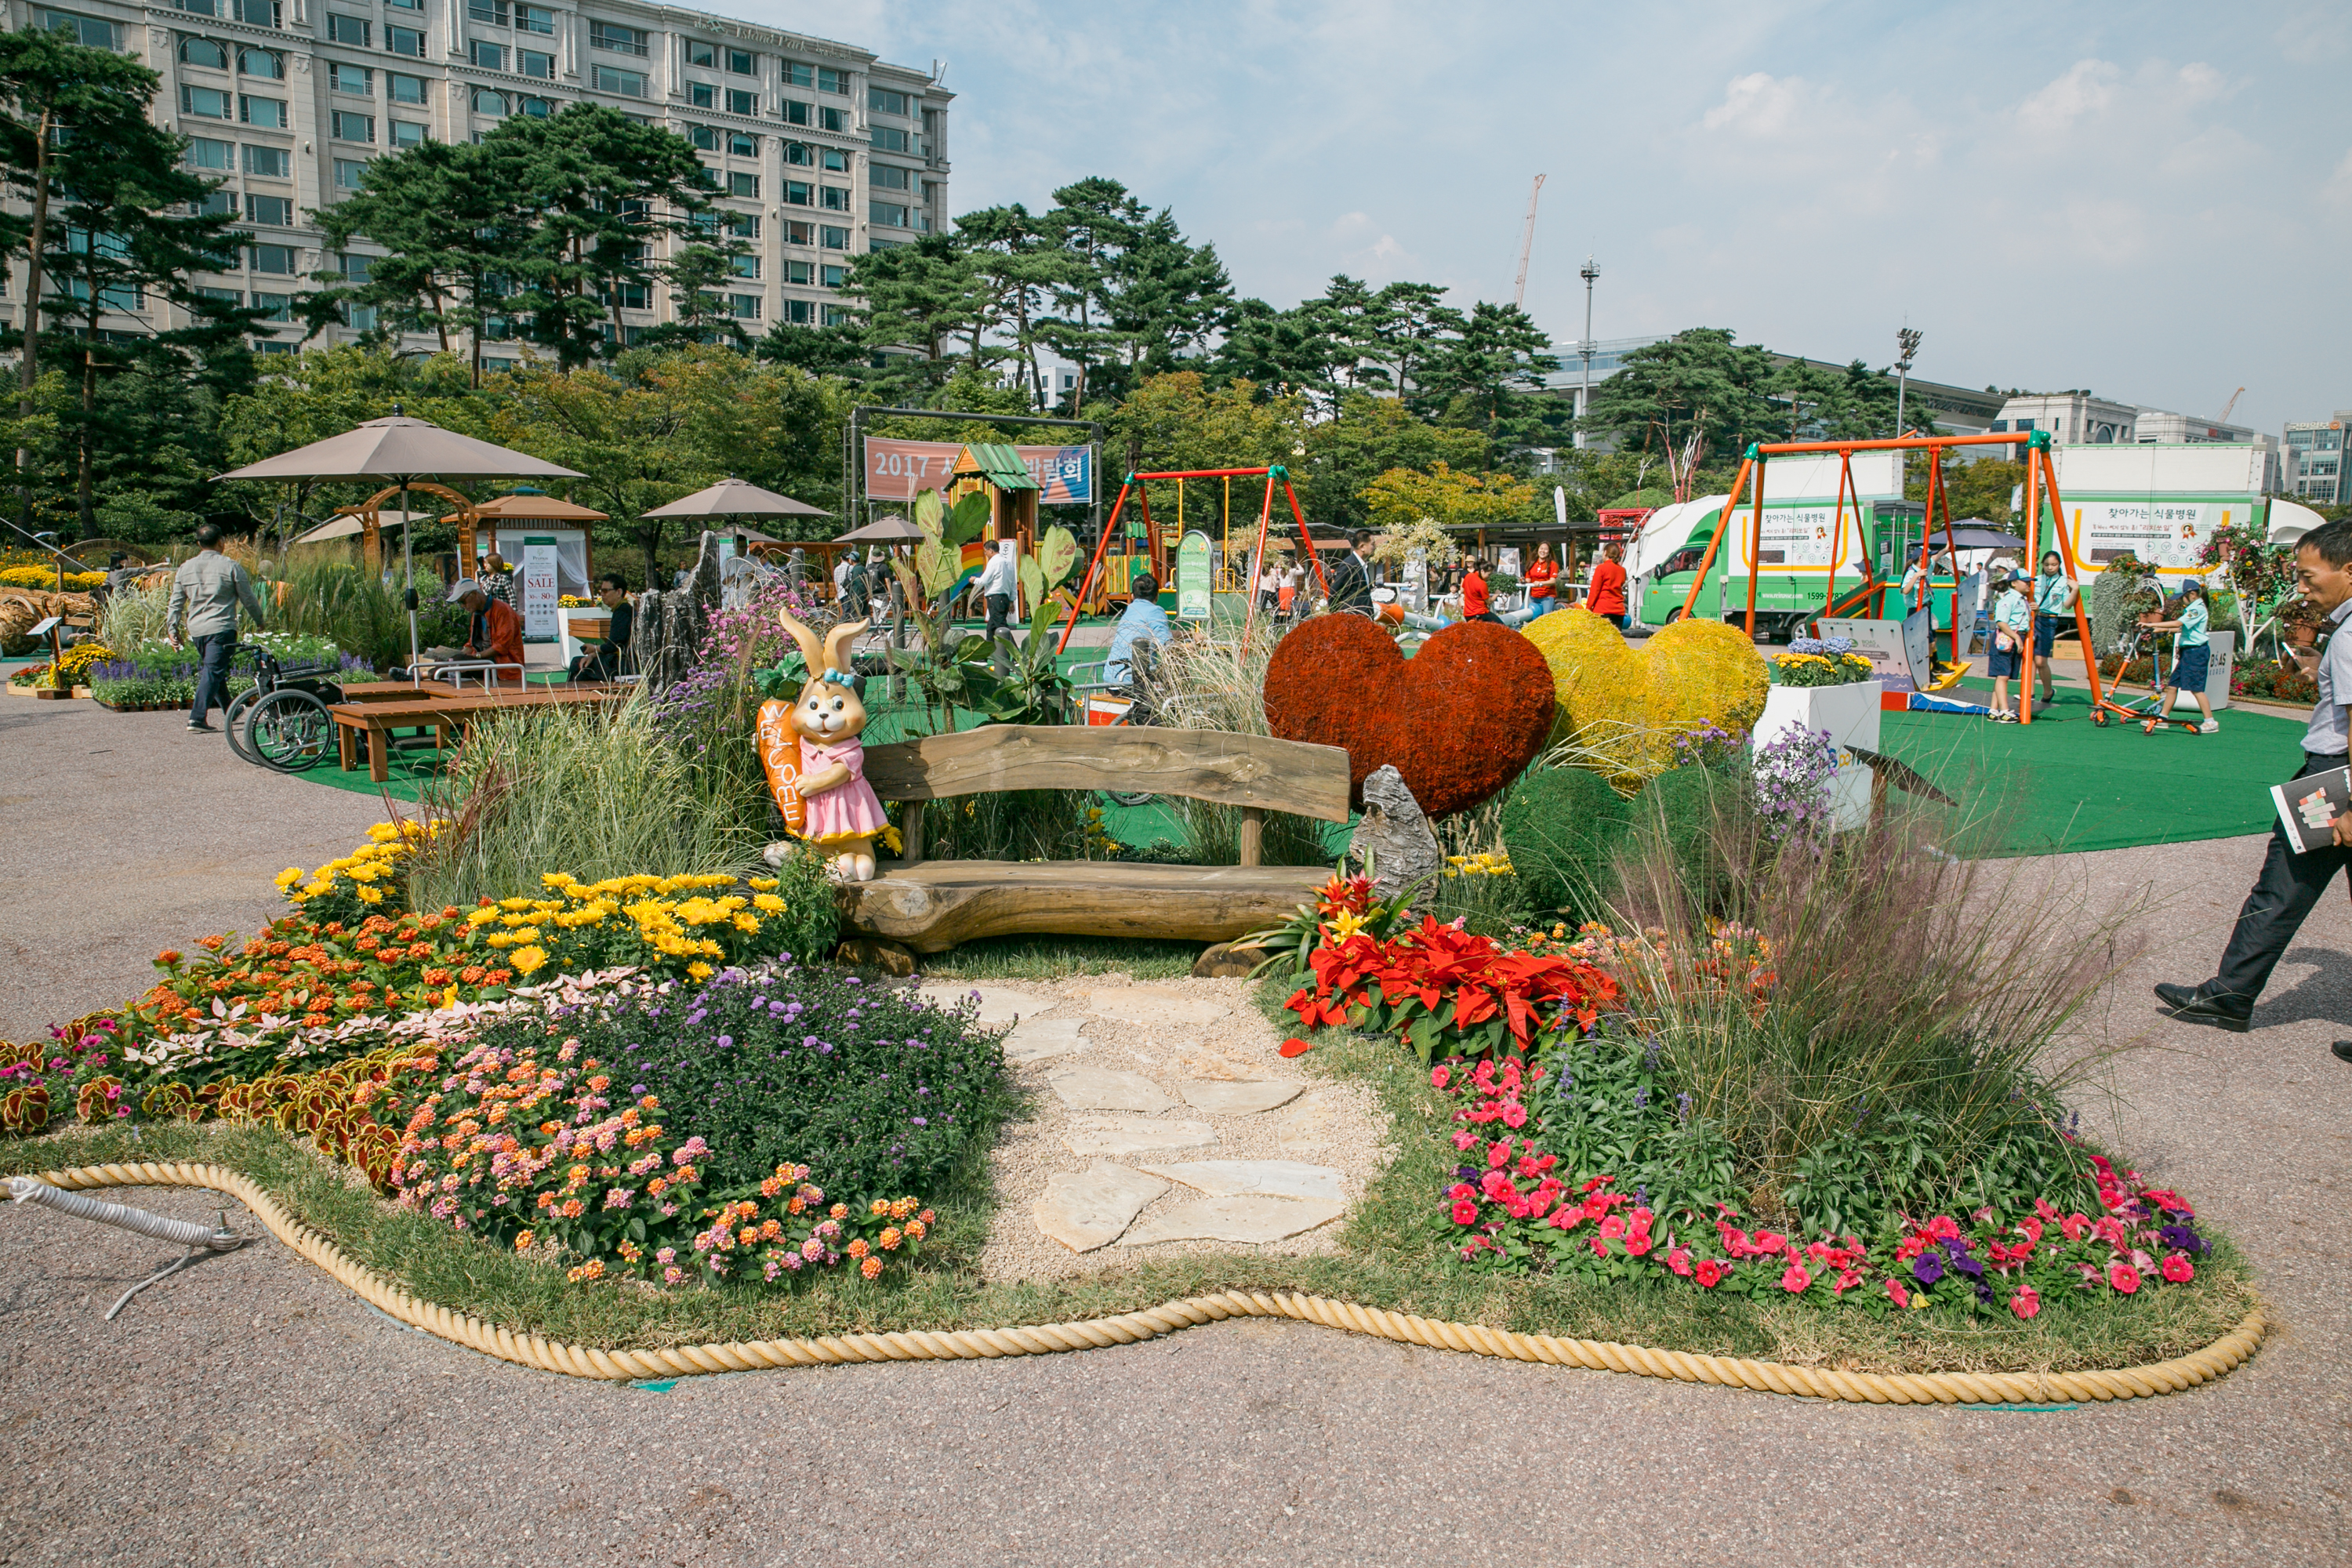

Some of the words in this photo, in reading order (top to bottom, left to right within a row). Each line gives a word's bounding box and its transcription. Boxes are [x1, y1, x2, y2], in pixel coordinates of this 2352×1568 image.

[736, 26, 775, 45] Island
[778, 34, 808, 53] Park
[2289, 421, 2328, 430] 국민일보
[875, 452, 929, 477] 2017
[1765, 514, 1794, 524] 찾아가는
[1796, 513, 1826, 523] 식물병원
[2108, 508, 2150, 519] 찾아가는
[2155, 509, 2196, 520] 식물병원
[528, 578, 555, 588] SALE
[759, 702, 800, 822] WELCOME
